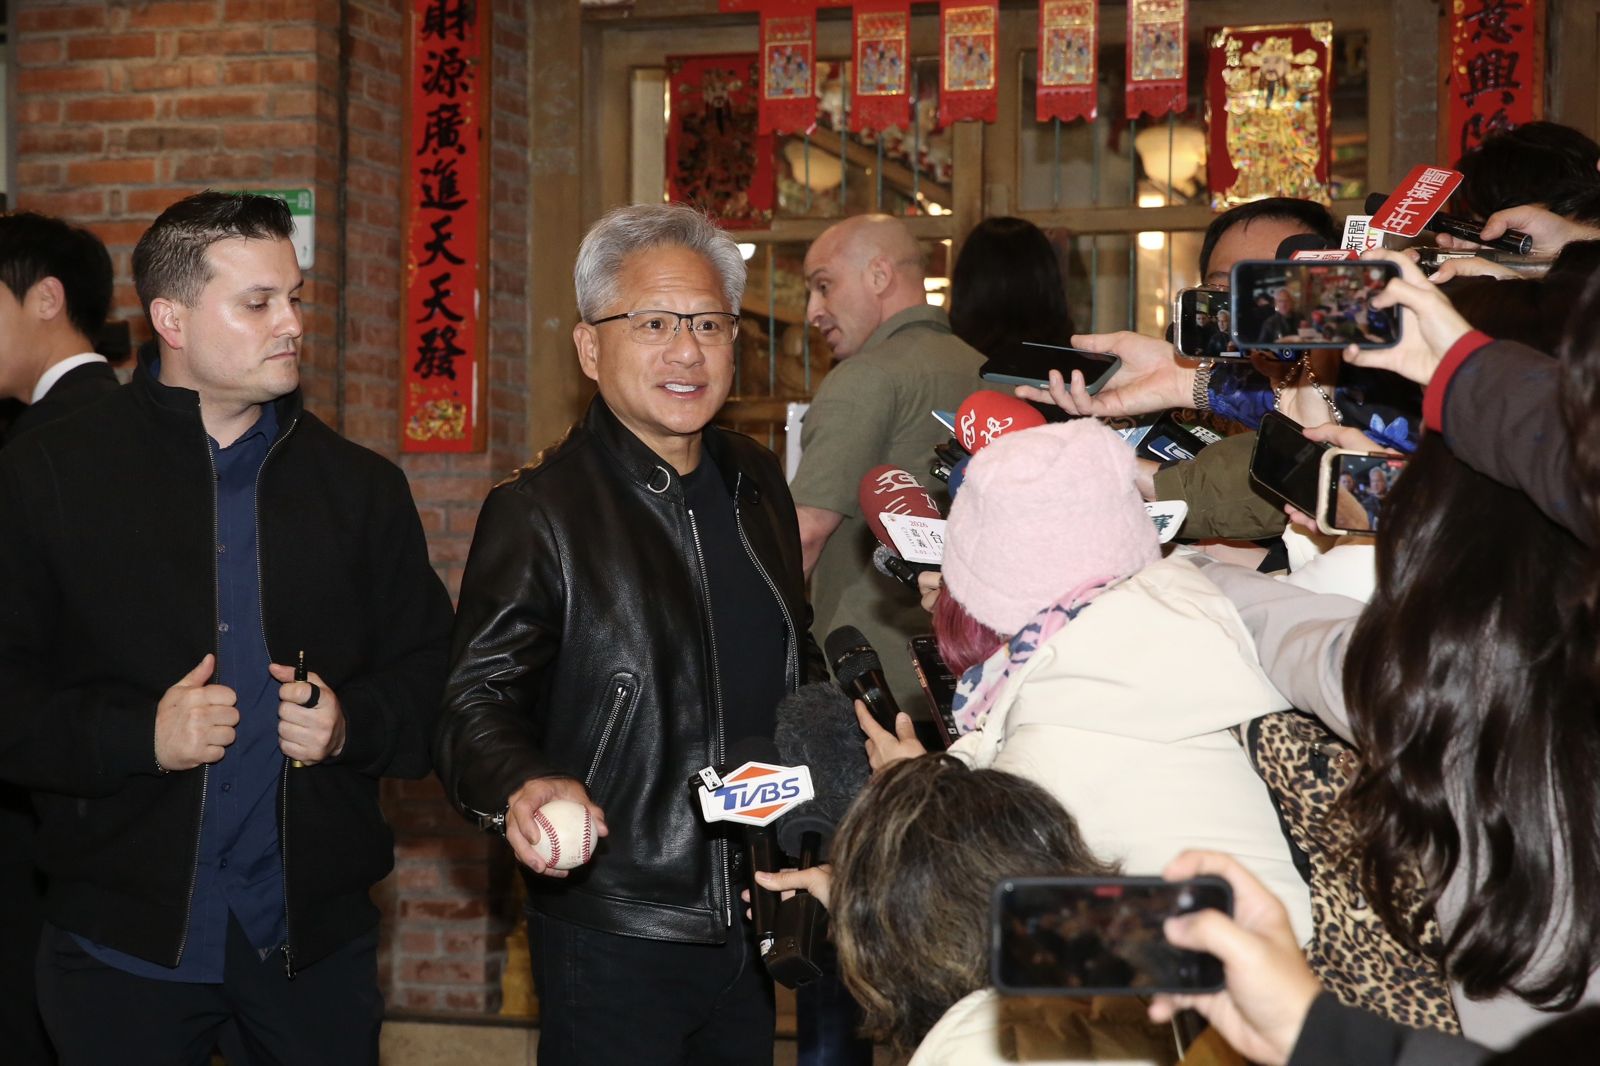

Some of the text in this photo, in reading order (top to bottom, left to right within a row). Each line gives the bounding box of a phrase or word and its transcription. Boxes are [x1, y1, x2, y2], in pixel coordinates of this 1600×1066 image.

[413, 0, 470, 380] 財源廣進天天發
[1382, 167, 1453, 233] 年代新聞
[713, 777, 801, 811] TVBS
